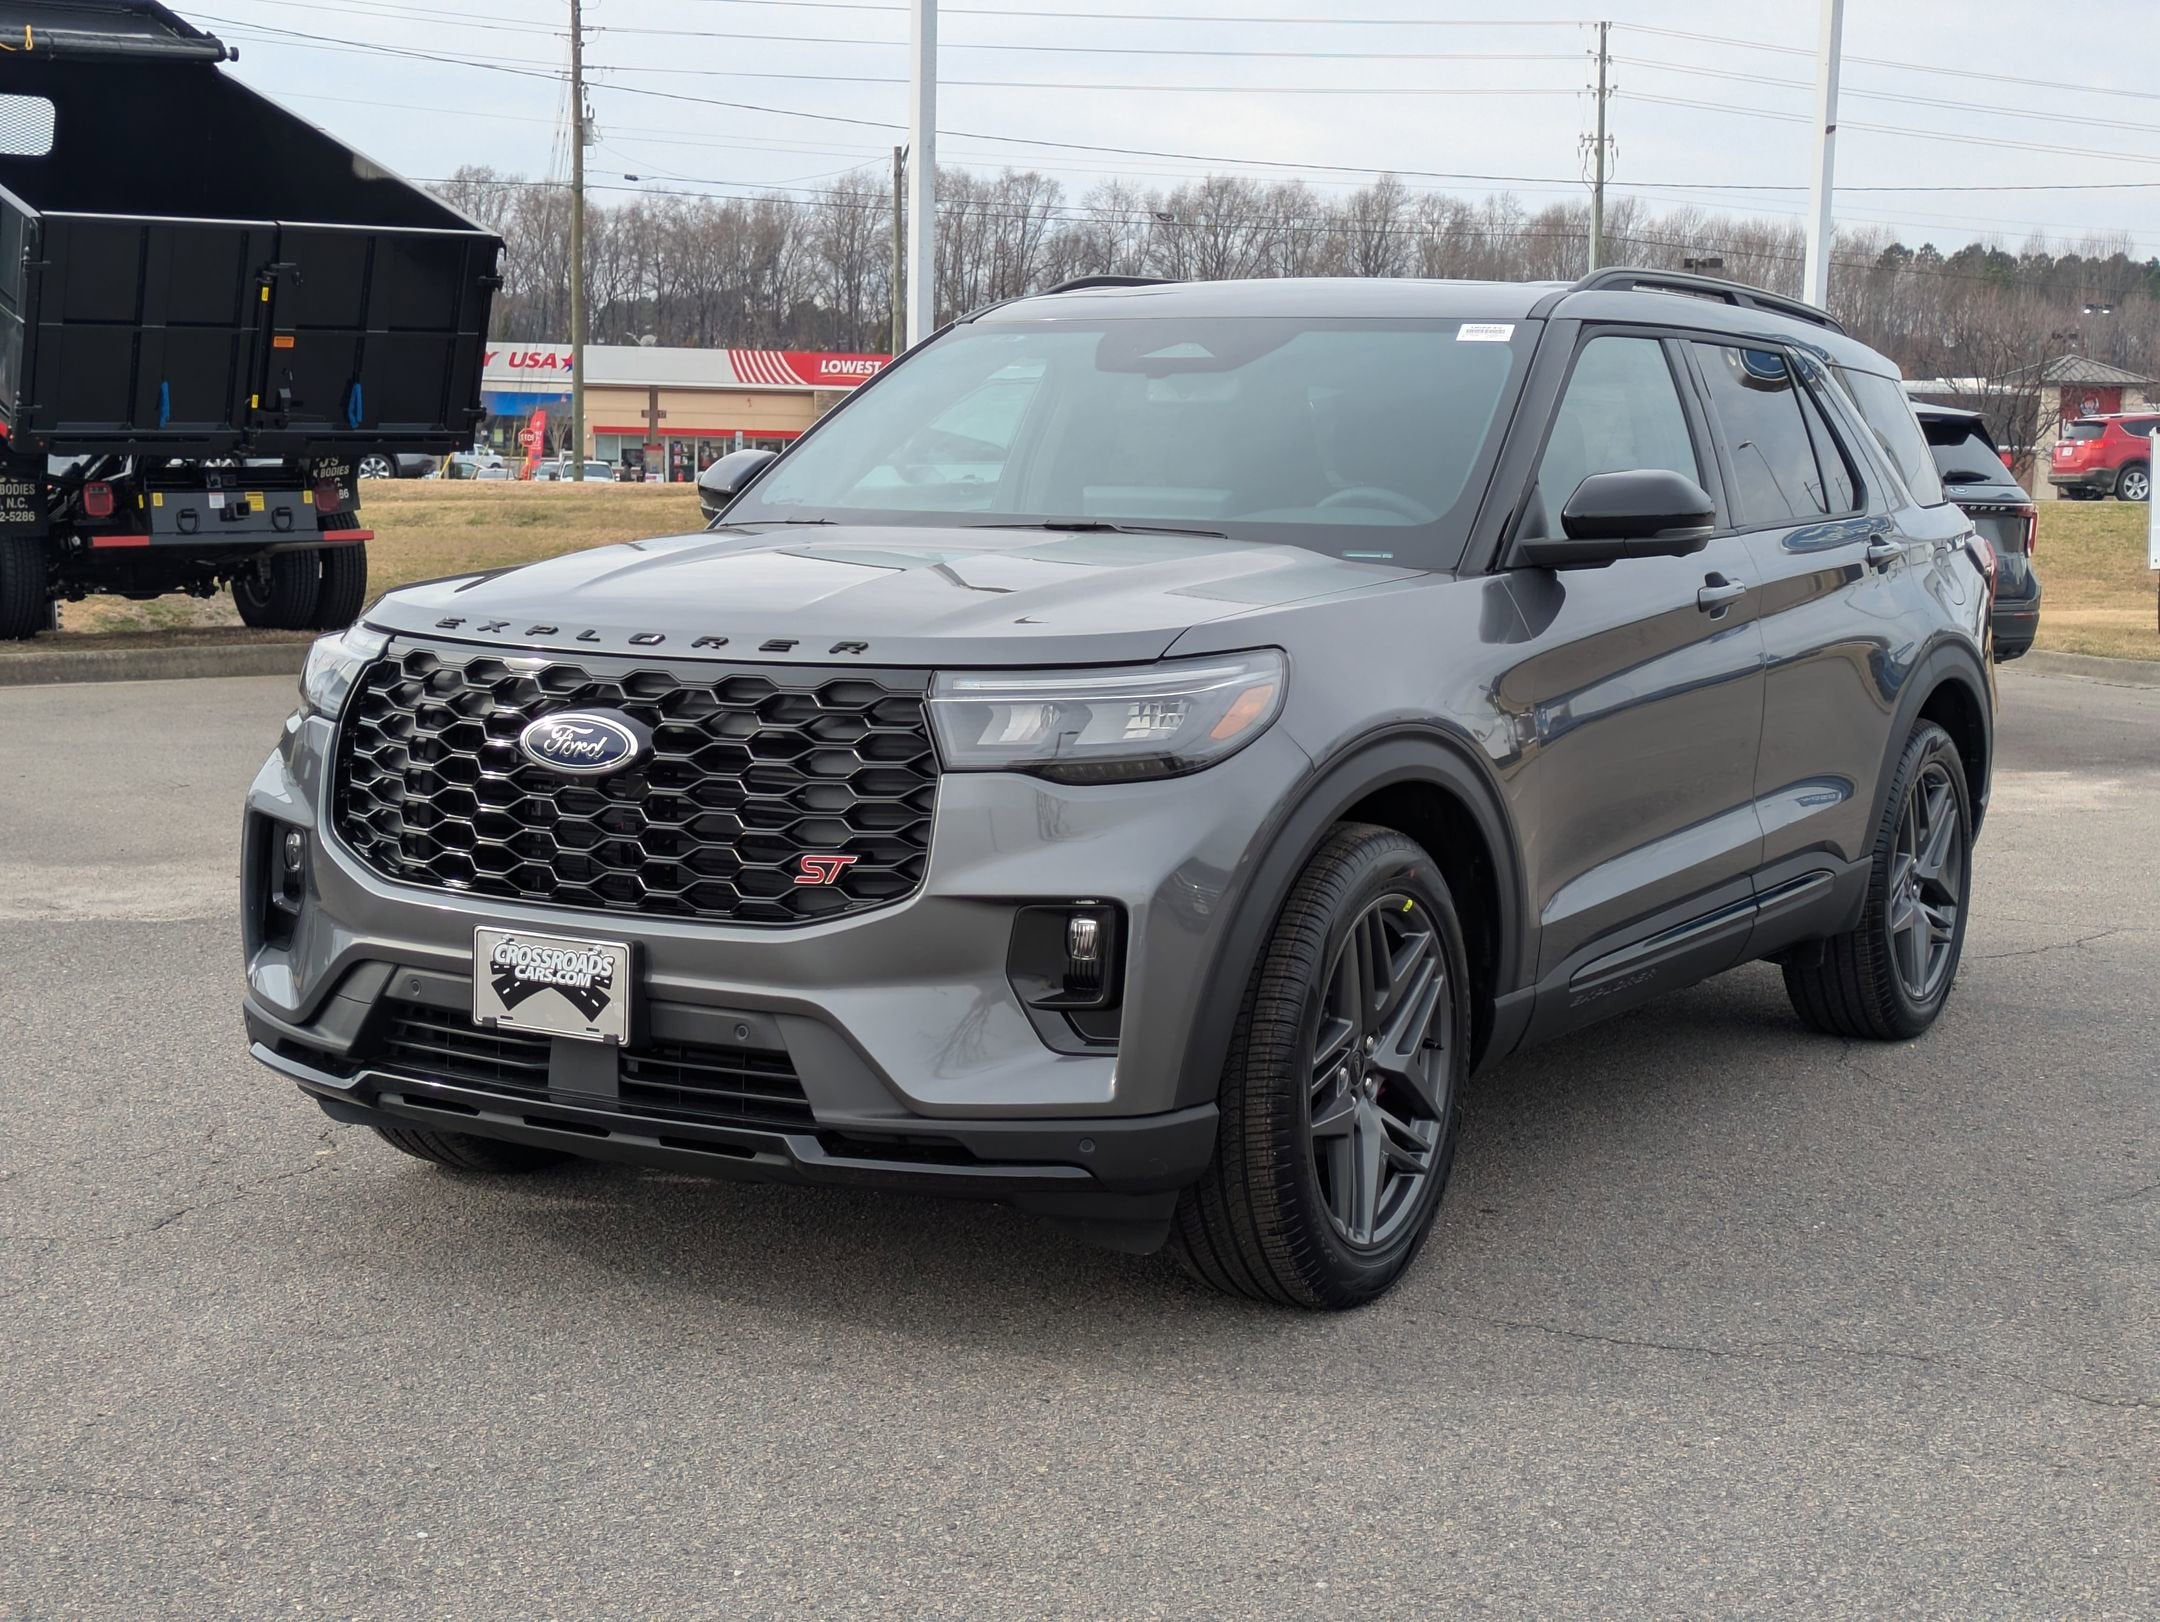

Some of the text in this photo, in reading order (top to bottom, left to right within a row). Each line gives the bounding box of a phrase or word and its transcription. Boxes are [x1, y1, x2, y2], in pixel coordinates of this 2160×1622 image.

[508, 351, 557, 368] USA
[820, 359, 882, 374] LOWEST
[320, 465, 350, 478] BODIES
[0, 483, 36, 495] BODIES
[435, 617, 869, 655] EXPLORER
[543, 724, 608, 759] Ford
[793, 854, 858, 885] ST
[493, 943, 615, 978] CROSSROADS
[514, 965, 592, 988] CARS.COM
